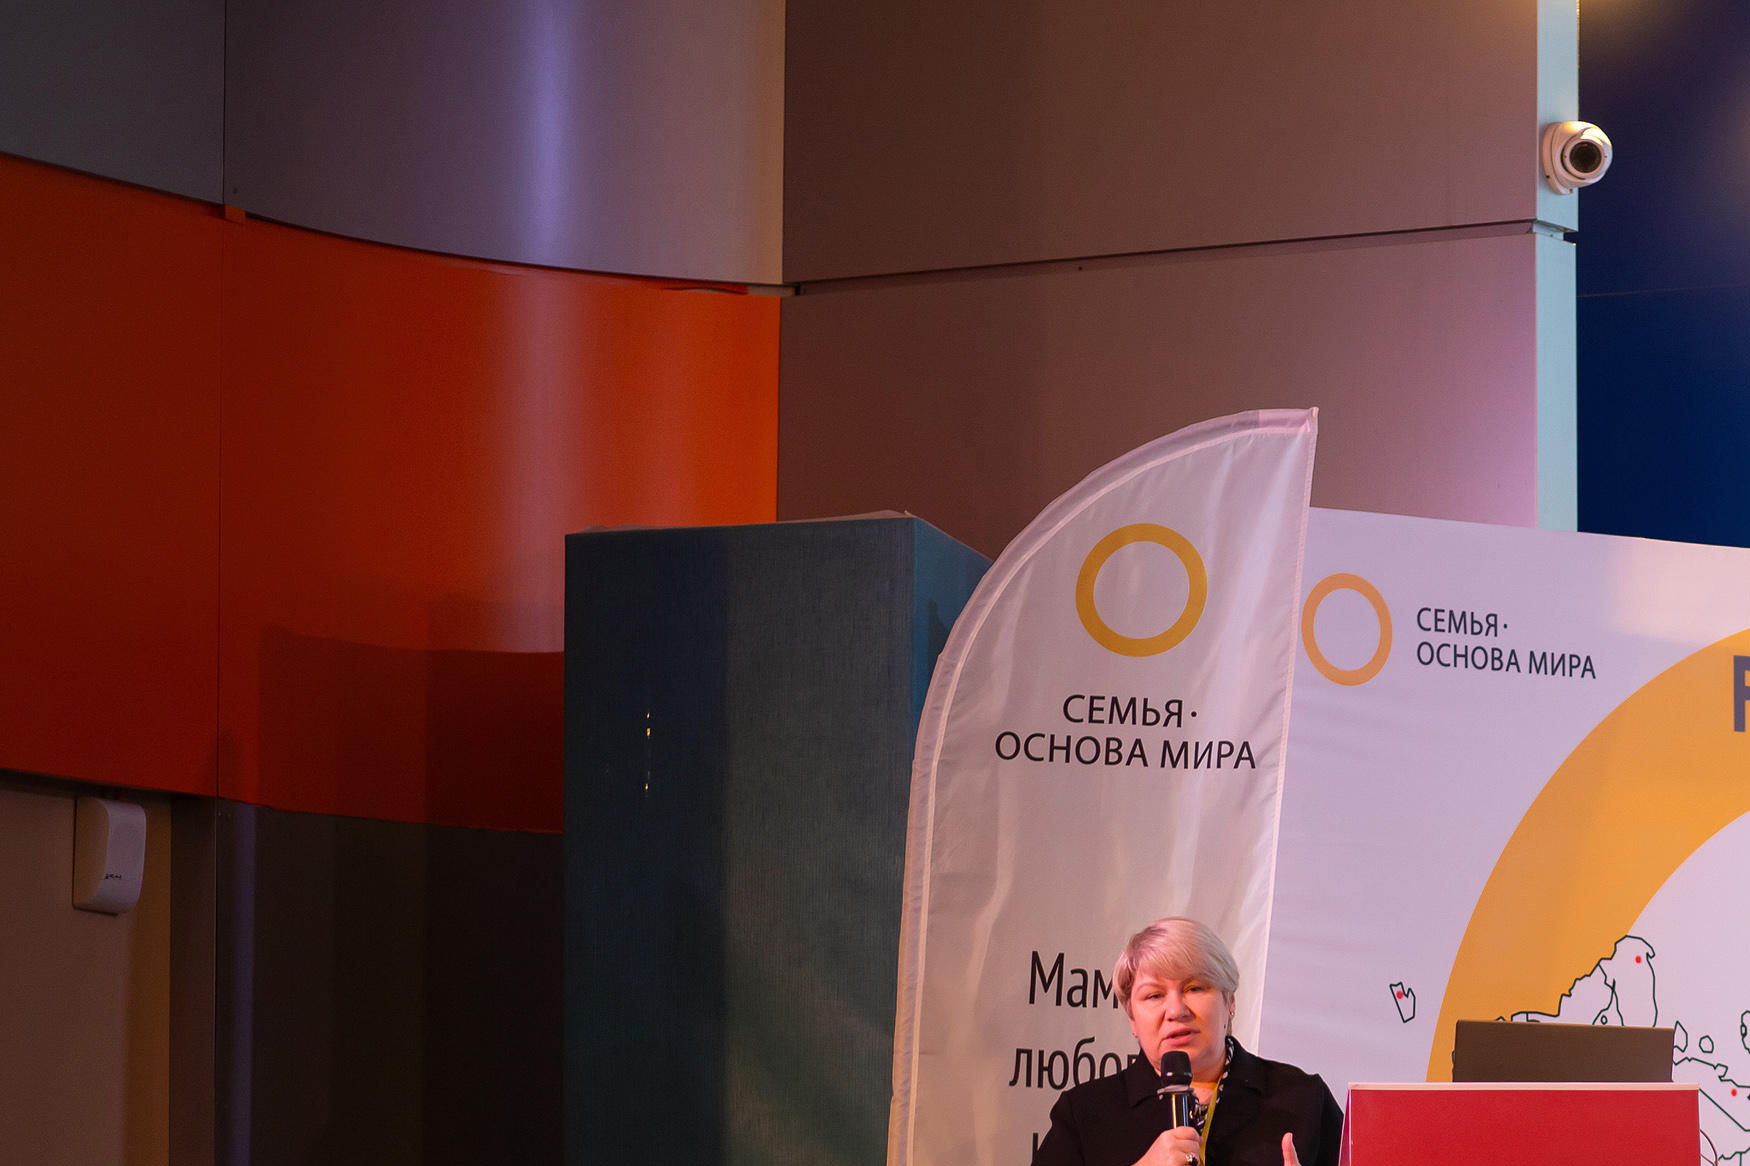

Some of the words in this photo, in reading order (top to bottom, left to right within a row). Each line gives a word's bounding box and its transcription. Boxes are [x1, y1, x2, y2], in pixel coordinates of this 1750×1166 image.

[1417, 641, 1521, 673] ОСНОВА
[1529, 650, 1597, 680] МИРА
[995, 731, 1149, 768] ОСНОВА
[1160, 739, 1256, 770] МИРА
